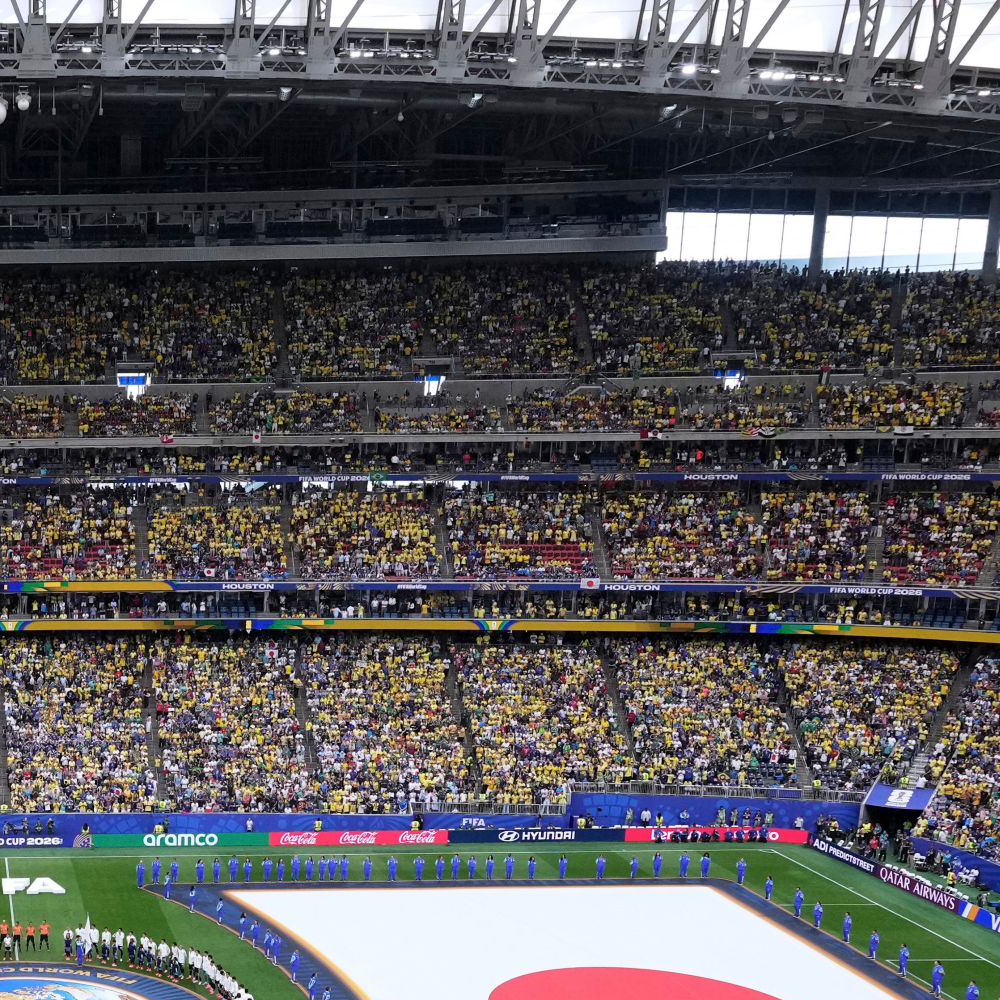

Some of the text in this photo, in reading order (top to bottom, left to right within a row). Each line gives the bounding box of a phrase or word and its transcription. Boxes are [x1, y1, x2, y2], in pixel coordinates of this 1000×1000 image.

[462, 818, 485, 826] FIFA
[6, 837, 25, 846] CUP
[143, 833, 218, 846] aramco
[280, 832, 319, 845] Coca-Cola
[339, 832, 378, 844] Coca-Cola
[398, 831, 438, 844] Coca-Cola
[522, 831, 575, 840] HYUNDAI
[813, 838, 874, 872] ADI PREDICTSTREET
[880, 867, 955, 910] QATAR AIRWAYS
[19, 967, 90, 976] WORLD
[97, 973, 137, 985] FIFA
